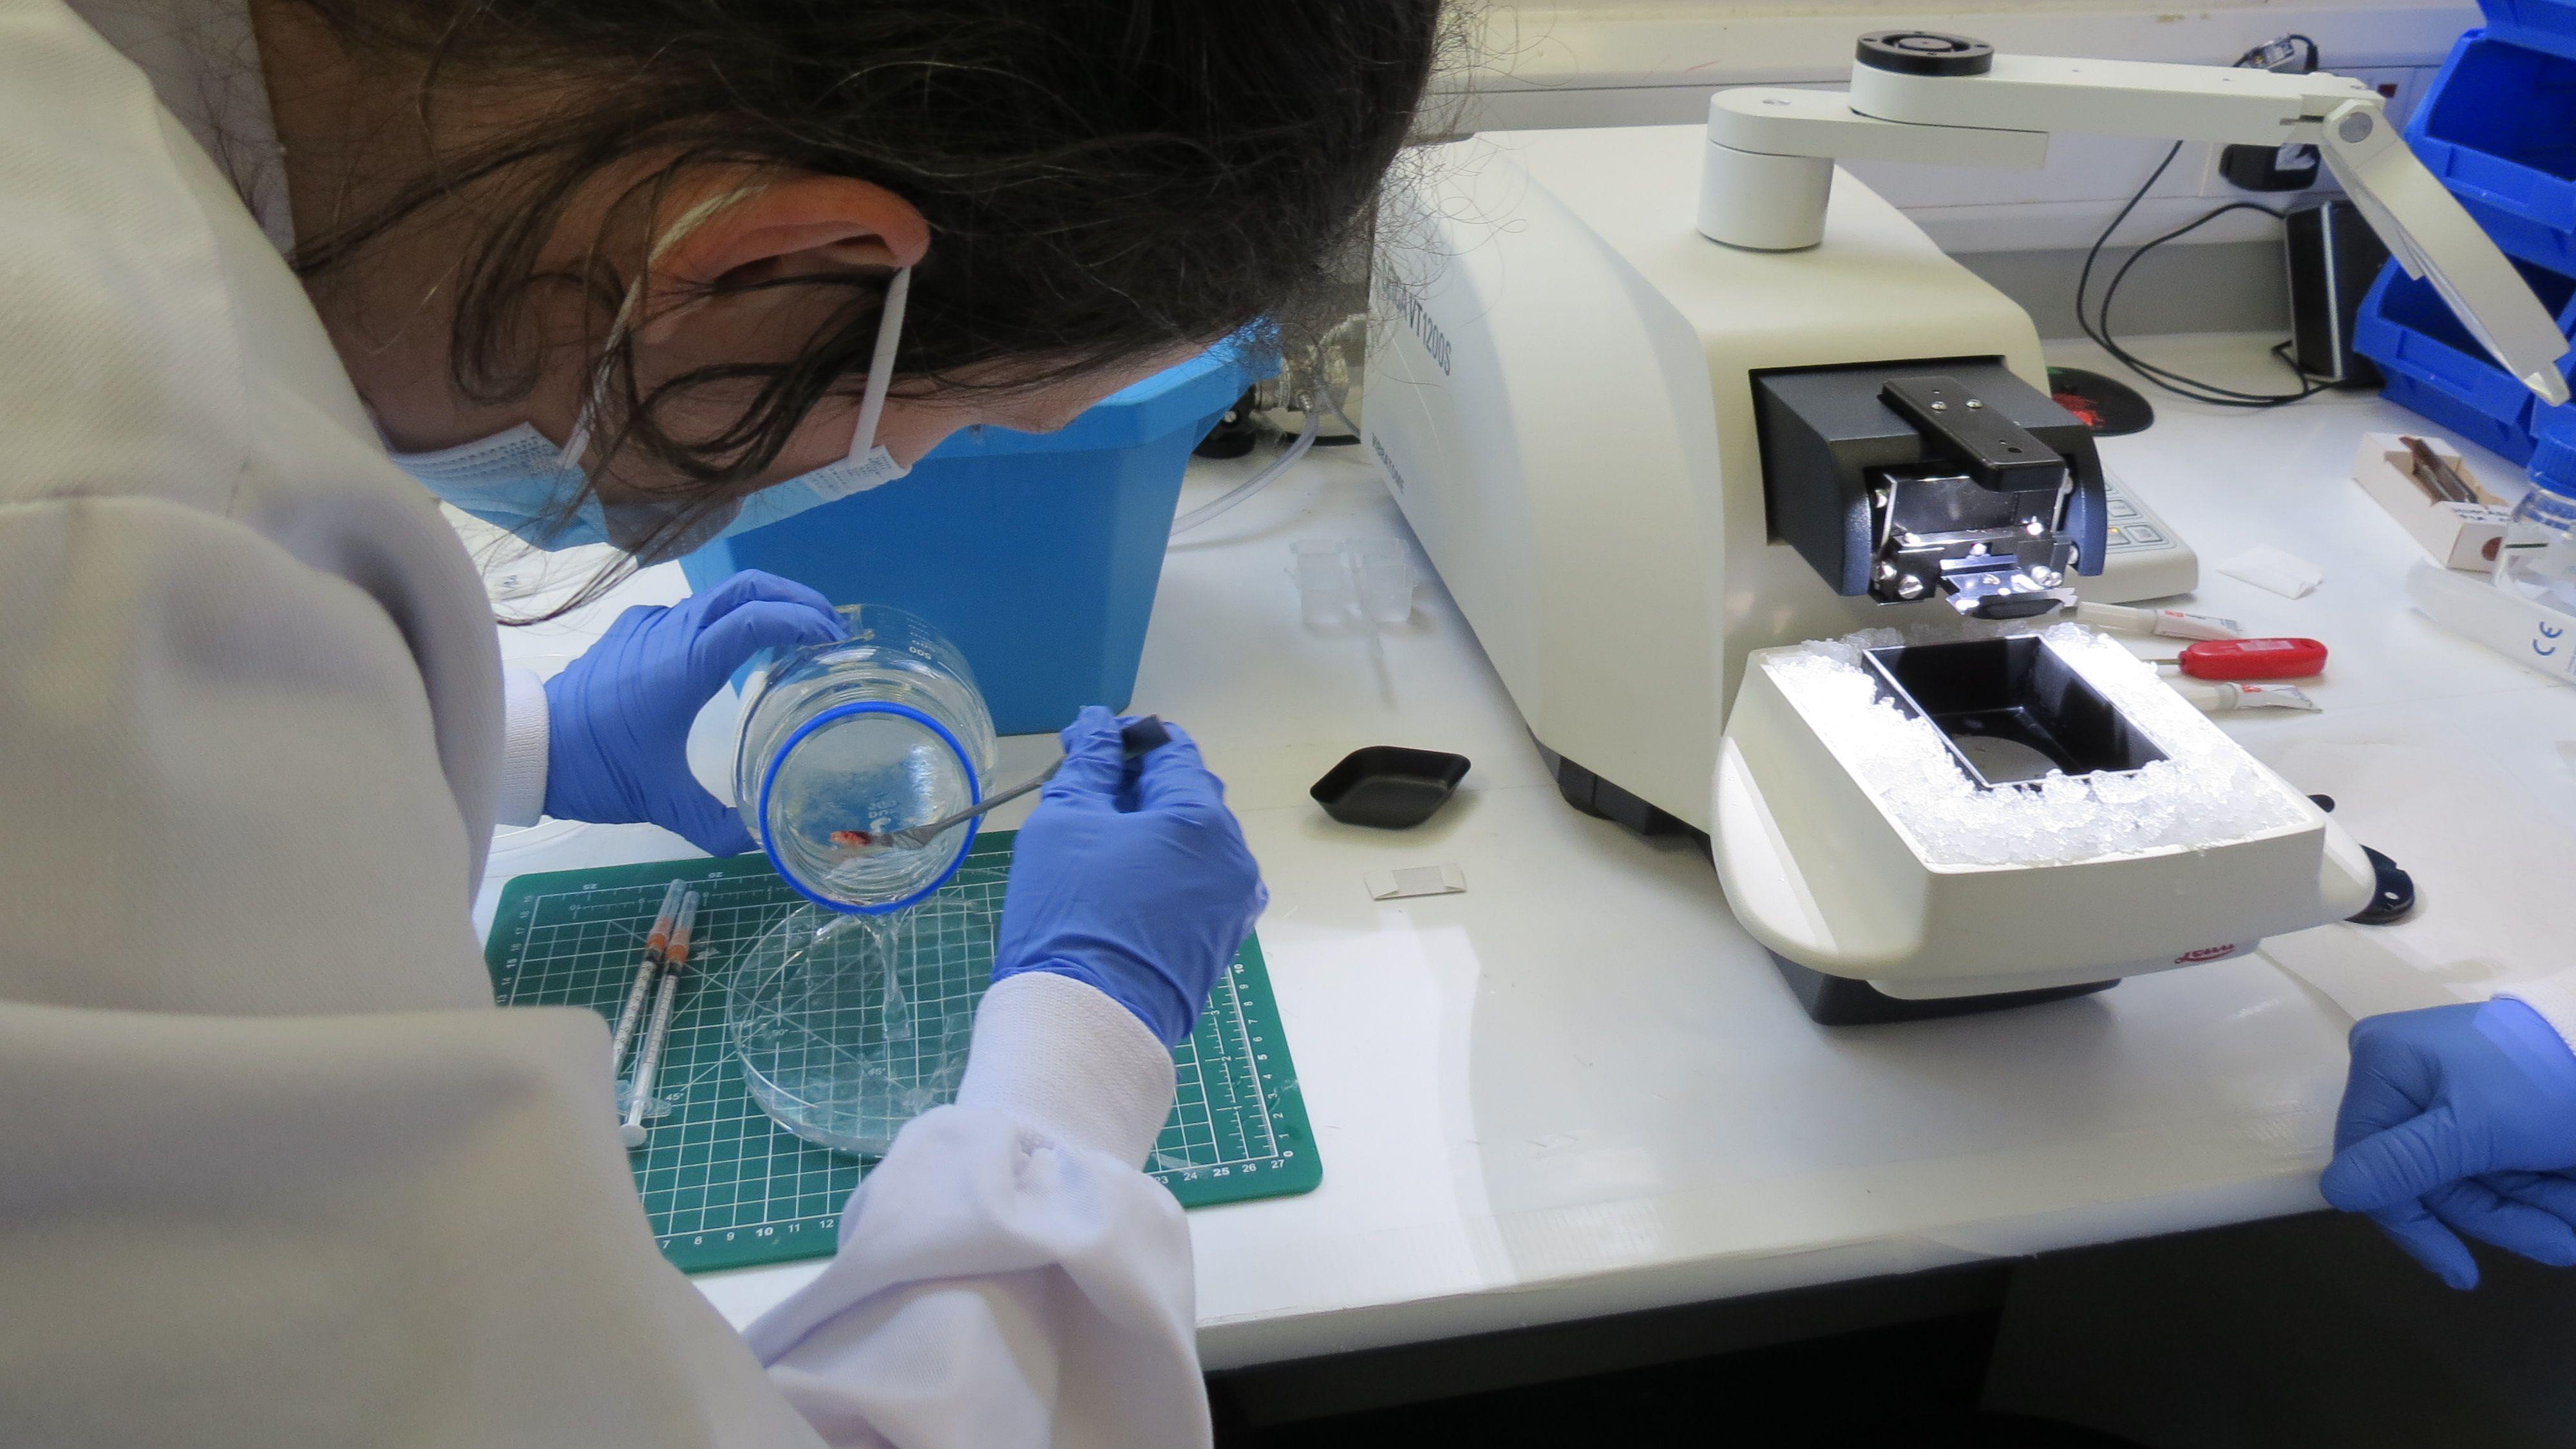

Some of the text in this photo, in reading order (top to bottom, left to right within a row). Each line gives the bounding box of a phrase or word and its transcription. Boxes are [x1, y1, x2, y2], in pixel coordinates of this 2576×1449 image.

[1234, 963, 1244, 974] 10
[1184, 1172, 1197, 1181] 24
[1213, 1167, 1231, 1177] 25
[1242, 1164, 1256, 1173] 26
[1271, 1159, 1285, 1168] 27
[662, 1218, 835, 1249] 7 8 9 10 11 12
